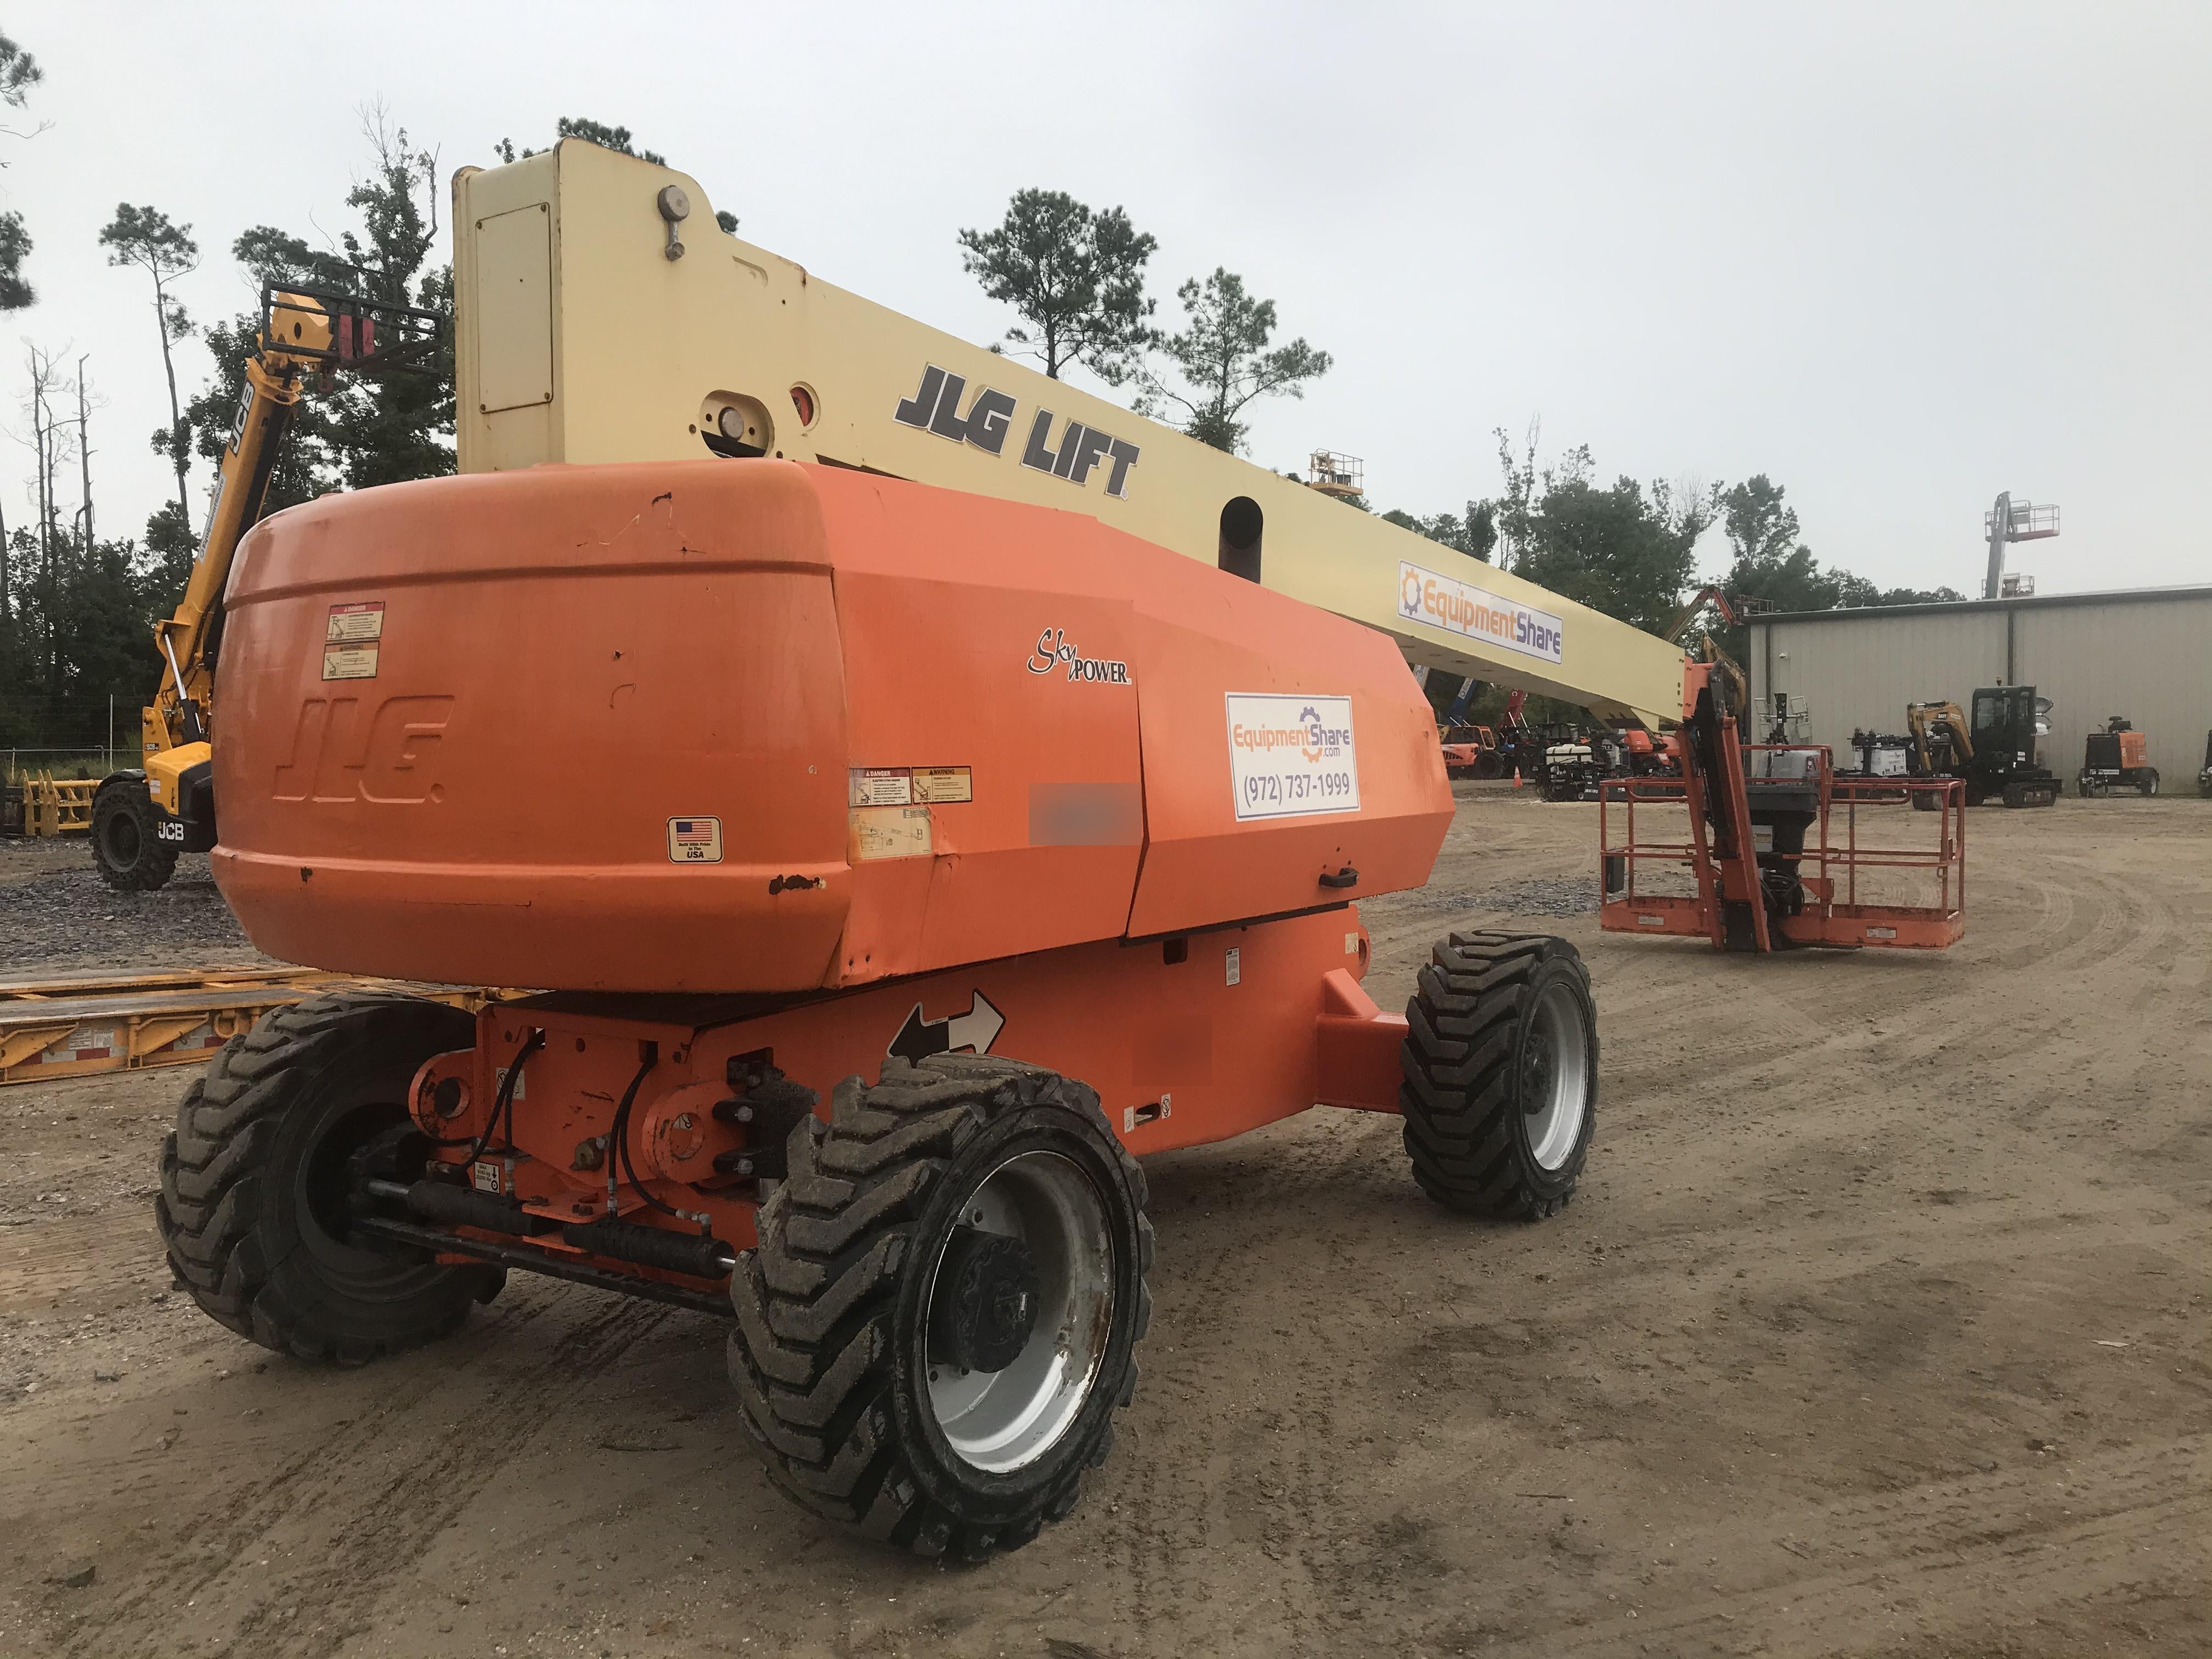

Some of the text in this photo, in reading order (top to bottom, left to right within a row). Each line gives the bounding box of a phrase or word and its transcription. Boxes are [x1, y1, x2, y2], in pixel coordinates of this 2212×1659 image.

[229, 381, 255, 455] JCB
[893, 363, 1141, 496] JLG LIFT
[1423, 579, 1561, 654] EquipmentShare
[1027, 629, 1127, 684] Sky POWER
[1233, 724, 1350, 753] EquipmentShare
[1323, 747, 1341, 757] .com
[1244, 772, 1350, 809] (972) 737-1999
[158, 821, 184, 840] JCB
